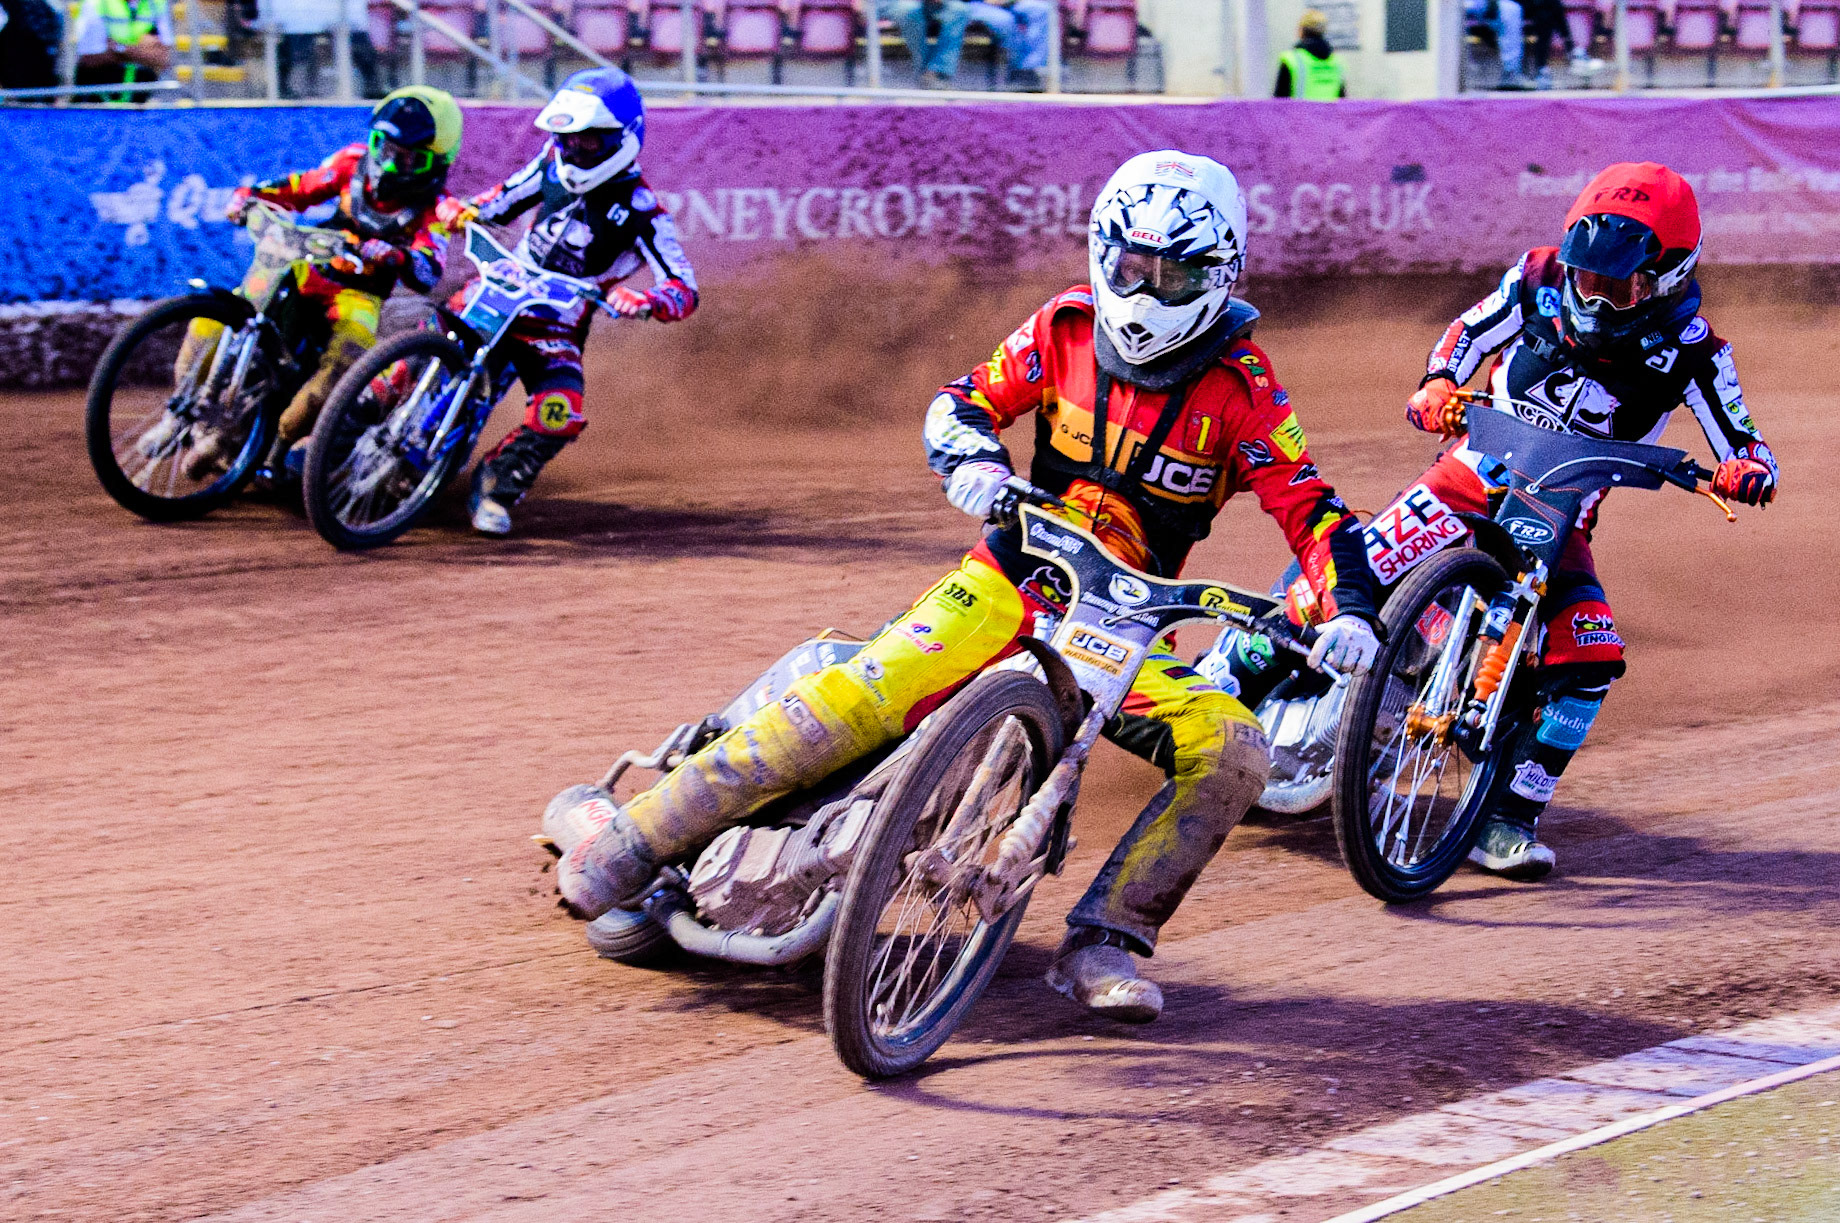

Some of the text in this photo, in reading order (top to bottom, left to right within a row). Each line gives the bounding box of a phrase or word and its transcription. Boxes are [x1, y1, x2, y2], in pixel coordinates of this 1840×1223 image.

[1131, 230, 1164, 244] BELL
[1197, 416, 1212, 452] 1
[1142, 454, 1217, 494] JCB
[1509, 520, 1549, 538] FRP
[1379, 517, 1459, 580] SHORING
[1071, 631, 1128, 663] JCB
[1250, 651, 1268, 670] OIL
